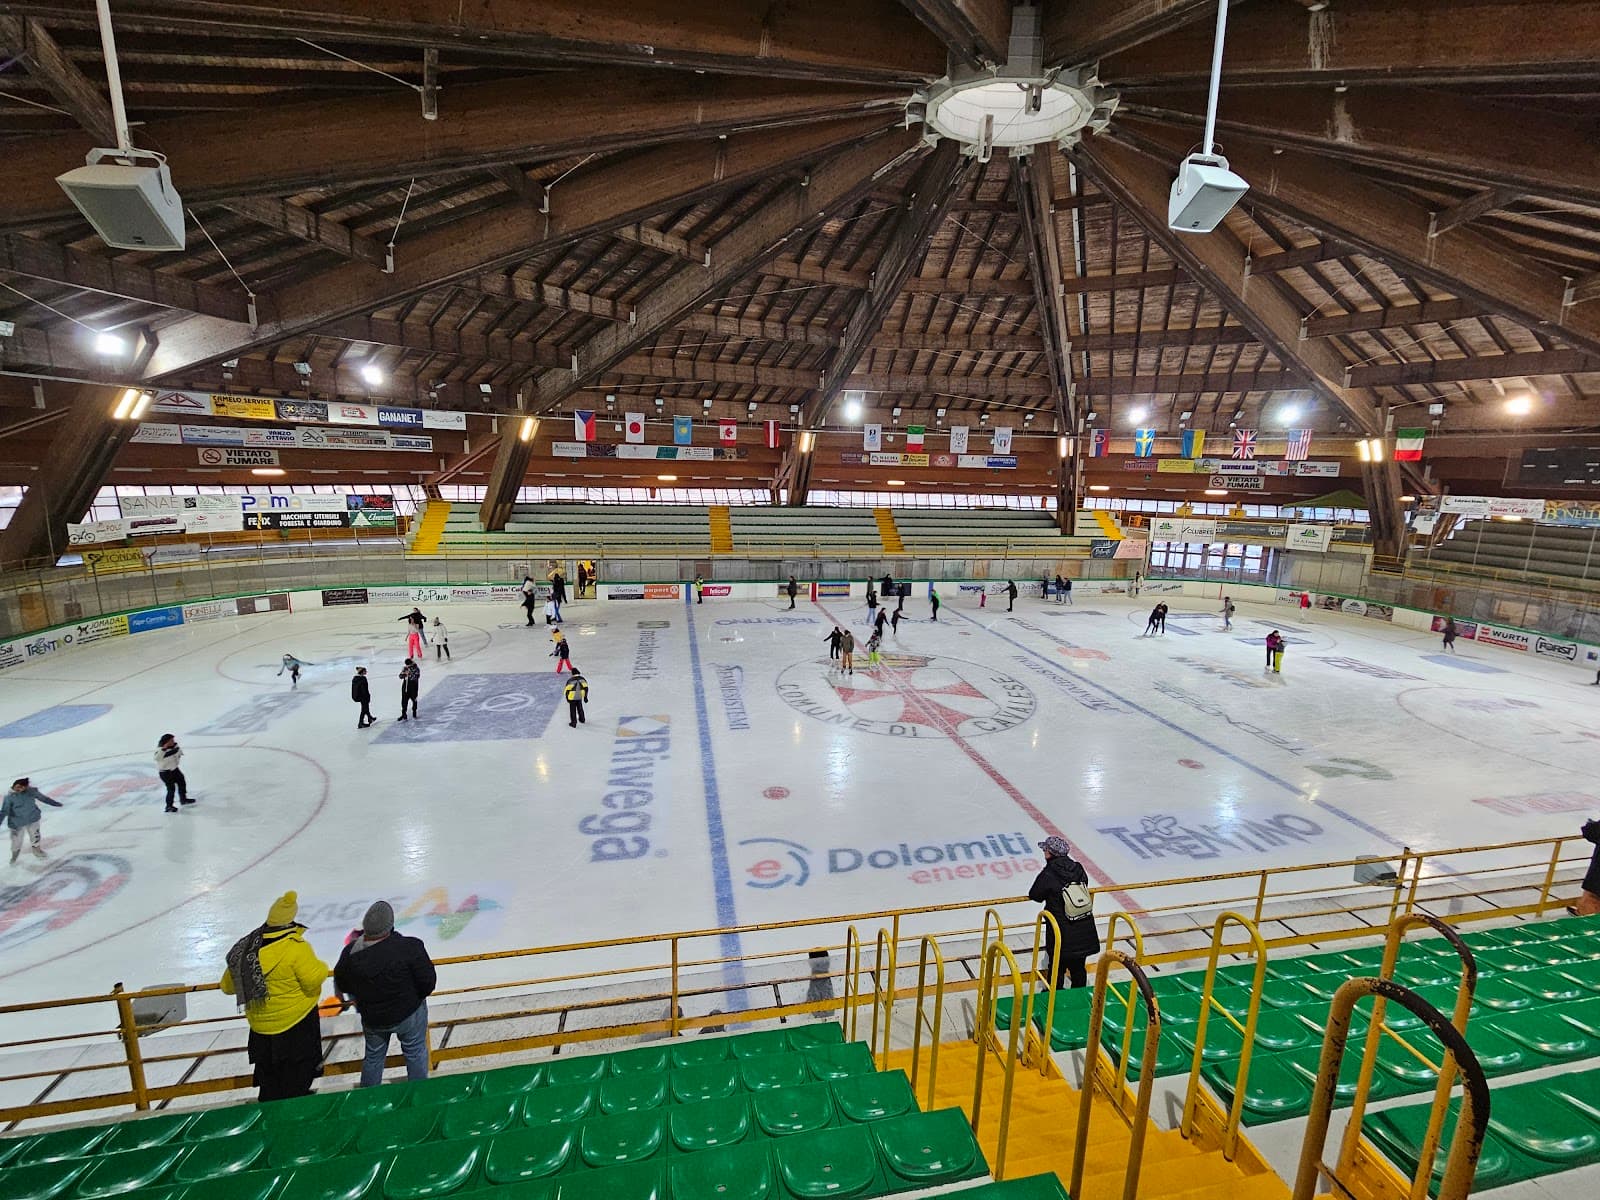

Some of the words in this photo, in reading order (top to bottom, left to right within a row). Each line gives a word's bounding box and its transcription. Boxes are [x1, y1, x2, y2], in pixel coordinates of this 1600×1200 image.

[379, 411, 417, 424] GANANET
[225, 449, 271, 457] VIETATO
[226, 457, 275, 465] FUMARE
[1227, 475, 1259, 483] VIETATO
[280, 513, 313, 521] MACCHINE
[1544, 505, 1600, 521] BONELL
[247, 516, 271, 526] FEIX
[312, 519, 343, 527] GIARDINO
[778, 684, 874, 731] COMUNE
[889, 724, 918, 737] DI
[973, 676, 1034, 732] CAVALESE
[578, 736, 671, 864] Riwega
[1095, 813, 1325, 860] TRENTINO
[828, 831, 1034, 875] Dolomiti
[907, 856, 1042, 885] energia
